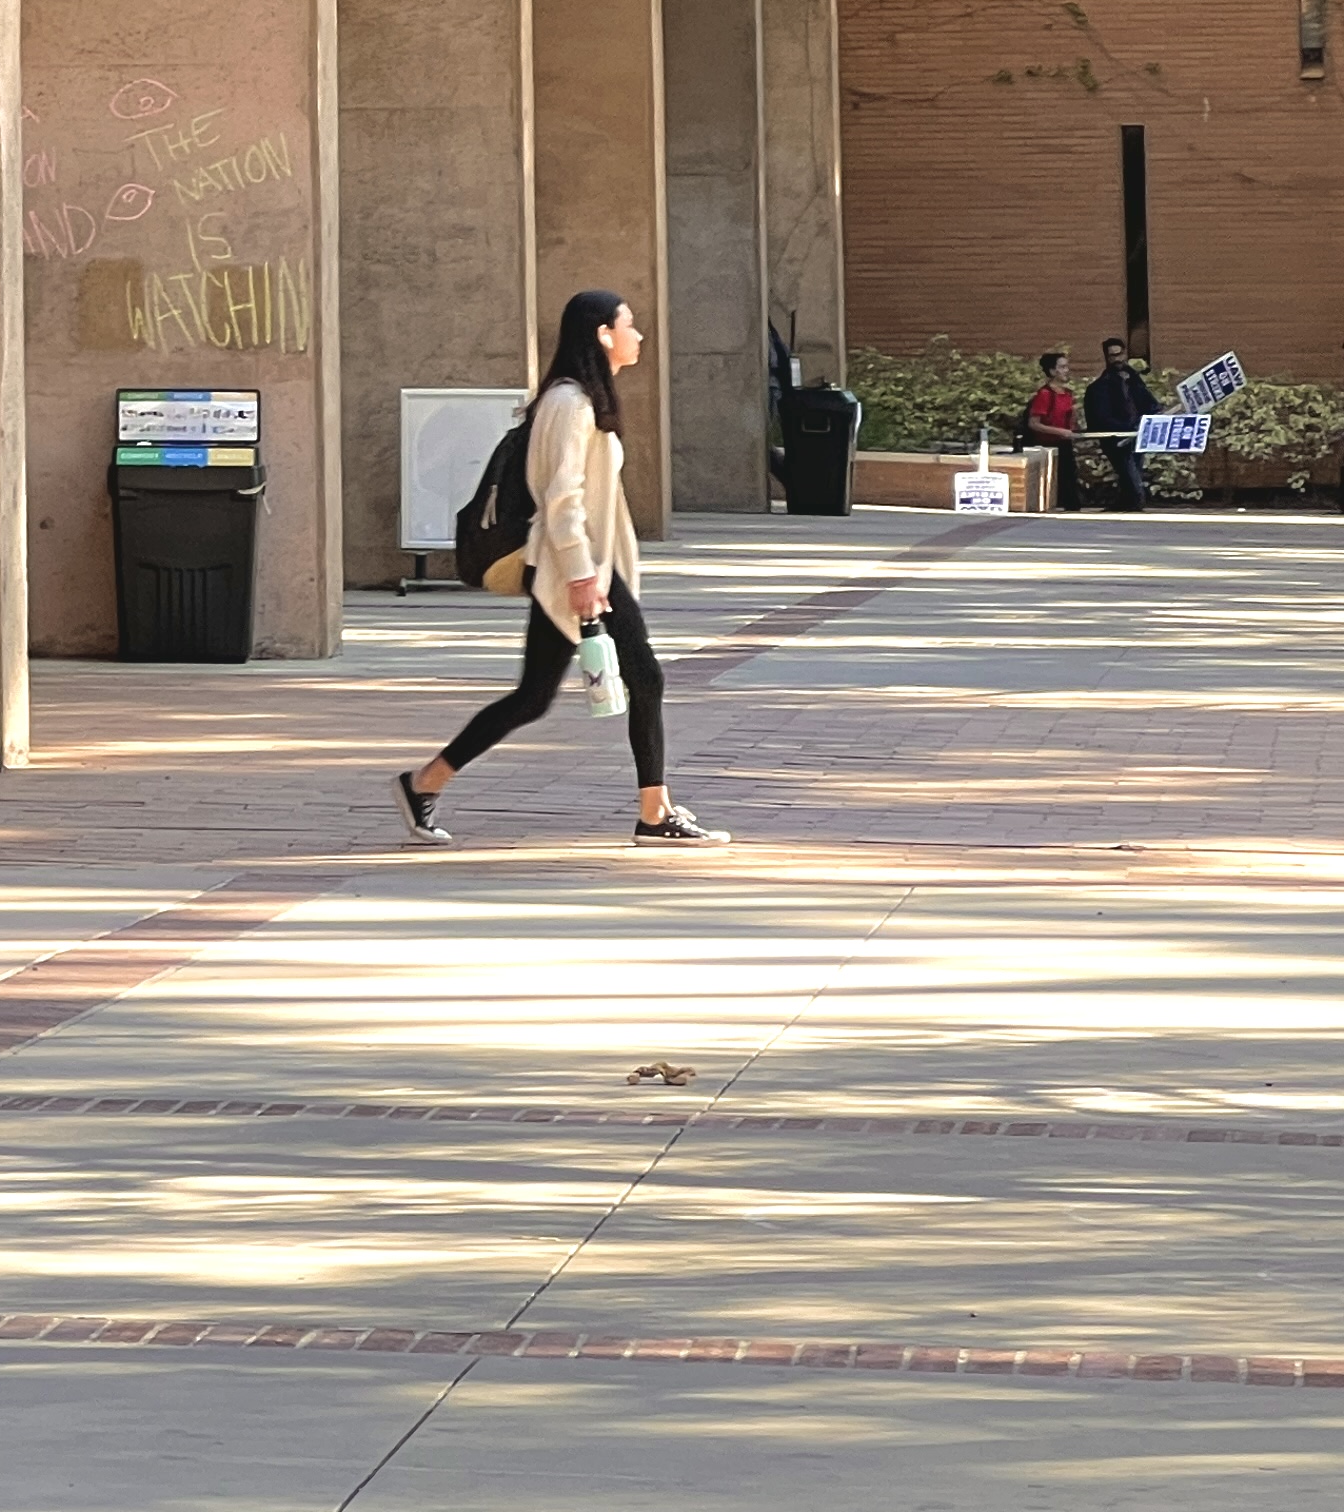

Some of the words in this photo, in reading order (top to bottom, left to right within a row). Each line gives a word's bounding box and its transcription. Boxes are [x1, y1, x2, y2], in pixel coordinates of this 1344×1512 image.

[126, 108, 227, 172] THE
[173, 132, 291, 208] NATION
[185, 212, 231, 272] IS
[1194, 418, 1209, 449] UAW
